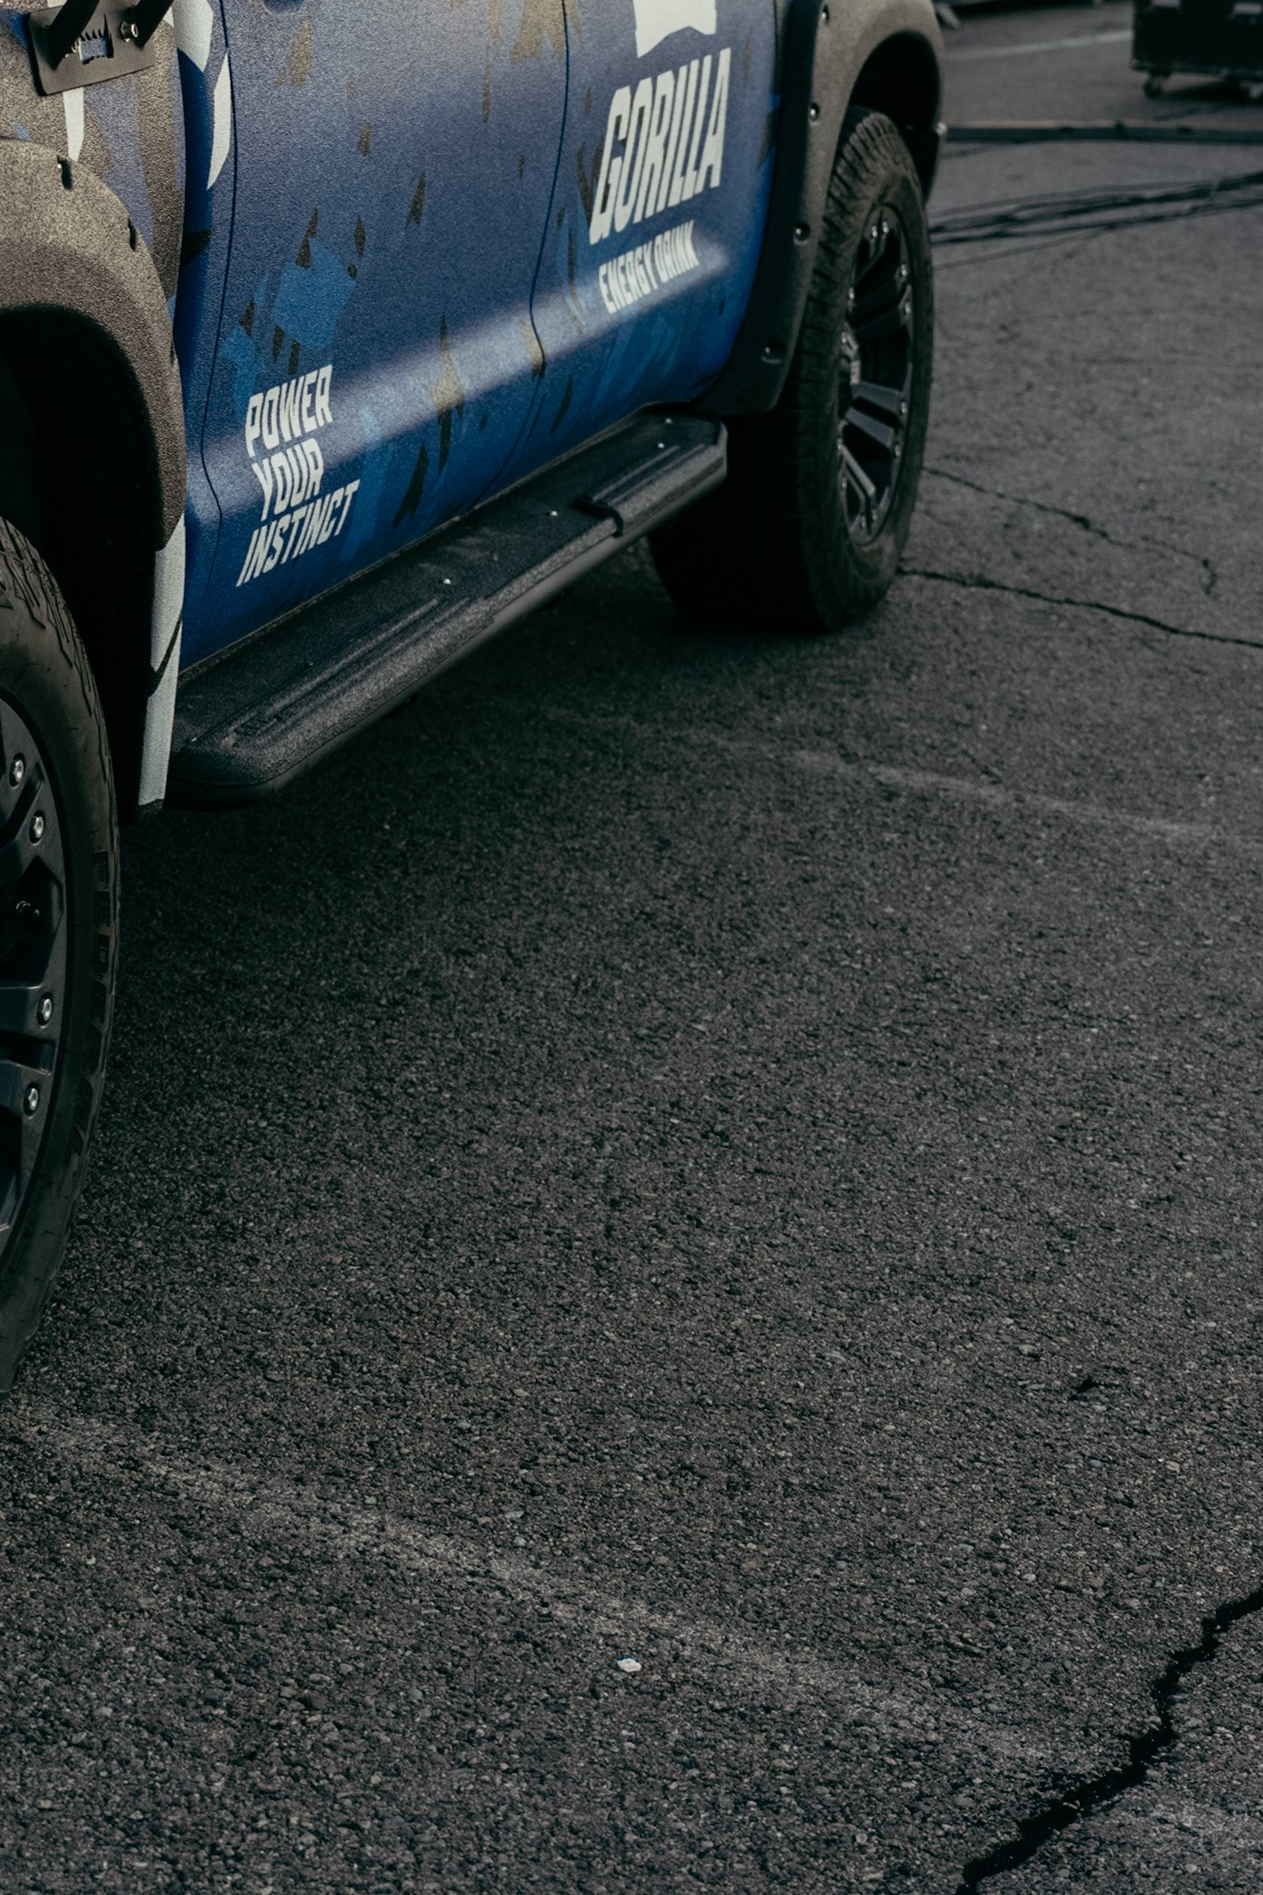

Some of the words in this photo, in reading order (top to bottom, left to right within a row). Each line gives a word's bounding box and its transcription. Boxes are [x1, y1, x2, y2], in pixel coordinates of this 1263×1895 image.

[589, 47, 732, 246] GORILLA
[598, 239, 658, 315] ENERGY
[654, 219, 700, 284] DRINK
[244, 363, 334, 459] POWER
[251, 437, 324, 522] YOUR
[235, 478, 361, 588] INSTINCT
